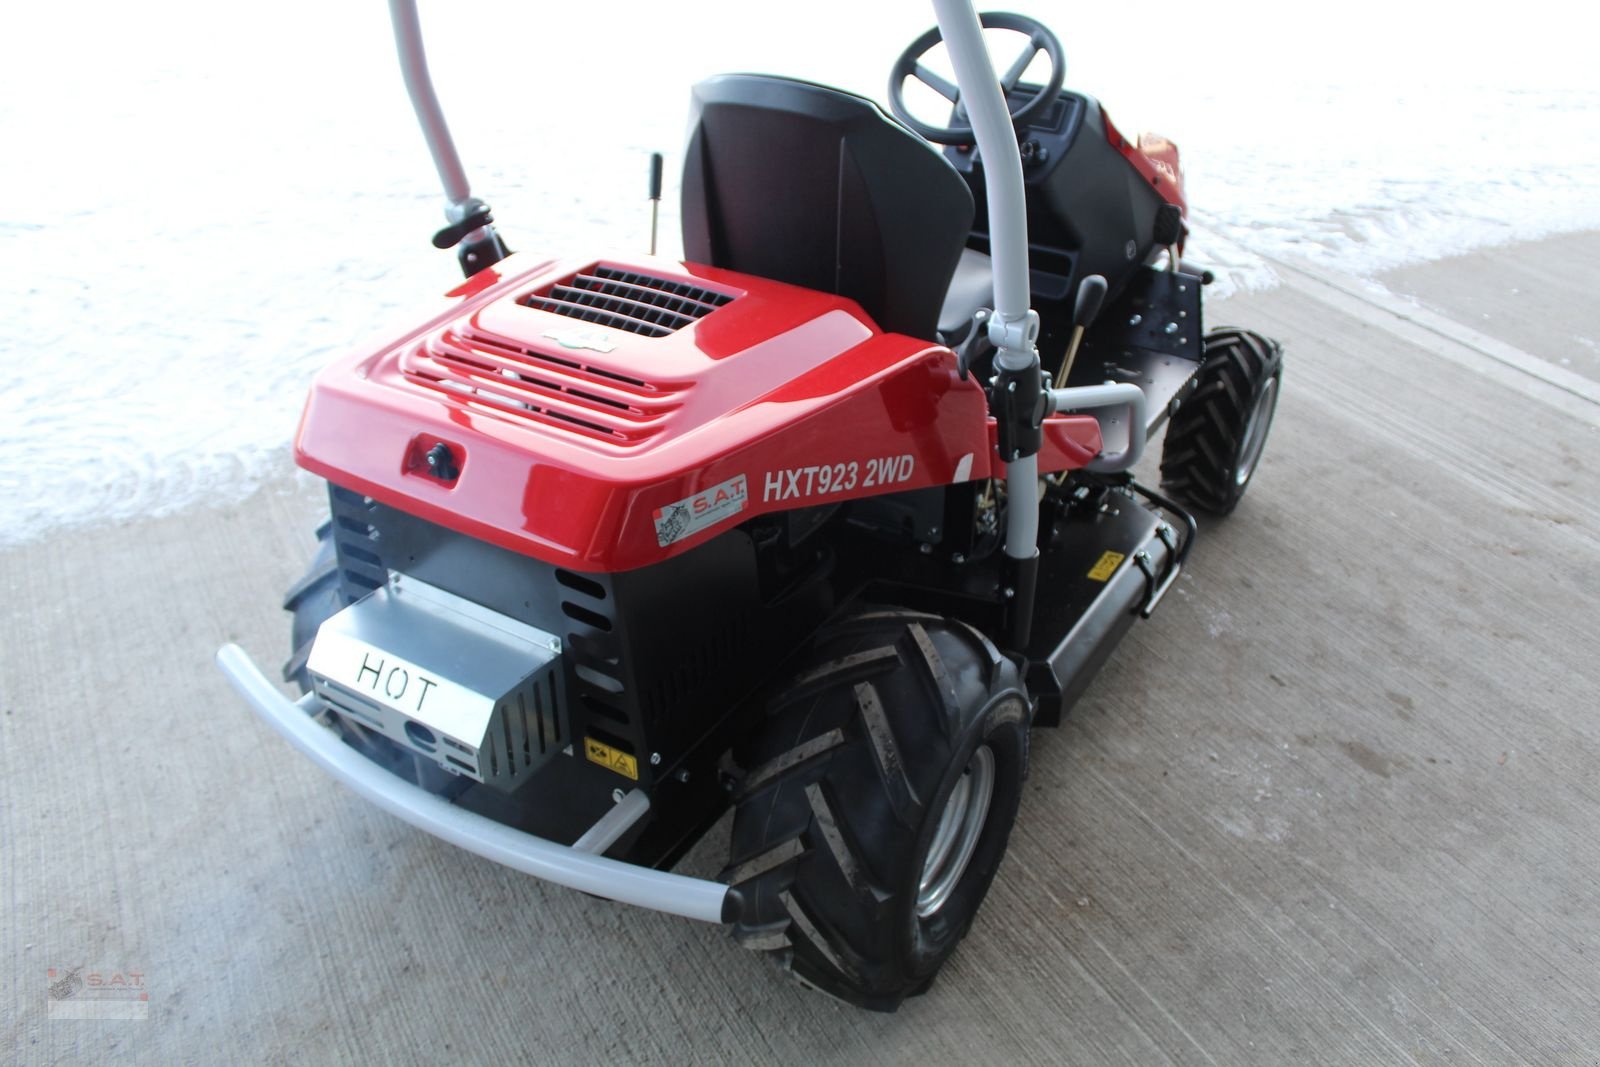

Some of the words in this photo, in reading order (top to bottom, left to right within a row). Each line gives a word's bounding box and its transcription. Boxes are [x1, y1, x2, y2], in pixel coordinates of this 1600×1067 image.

[692, 480, 745, 515] S.A.T.
[763, 461, 859, 503] HXT923
[862, 454, 914, 488] 2WD
[357, 652, 438, 712] HOT
